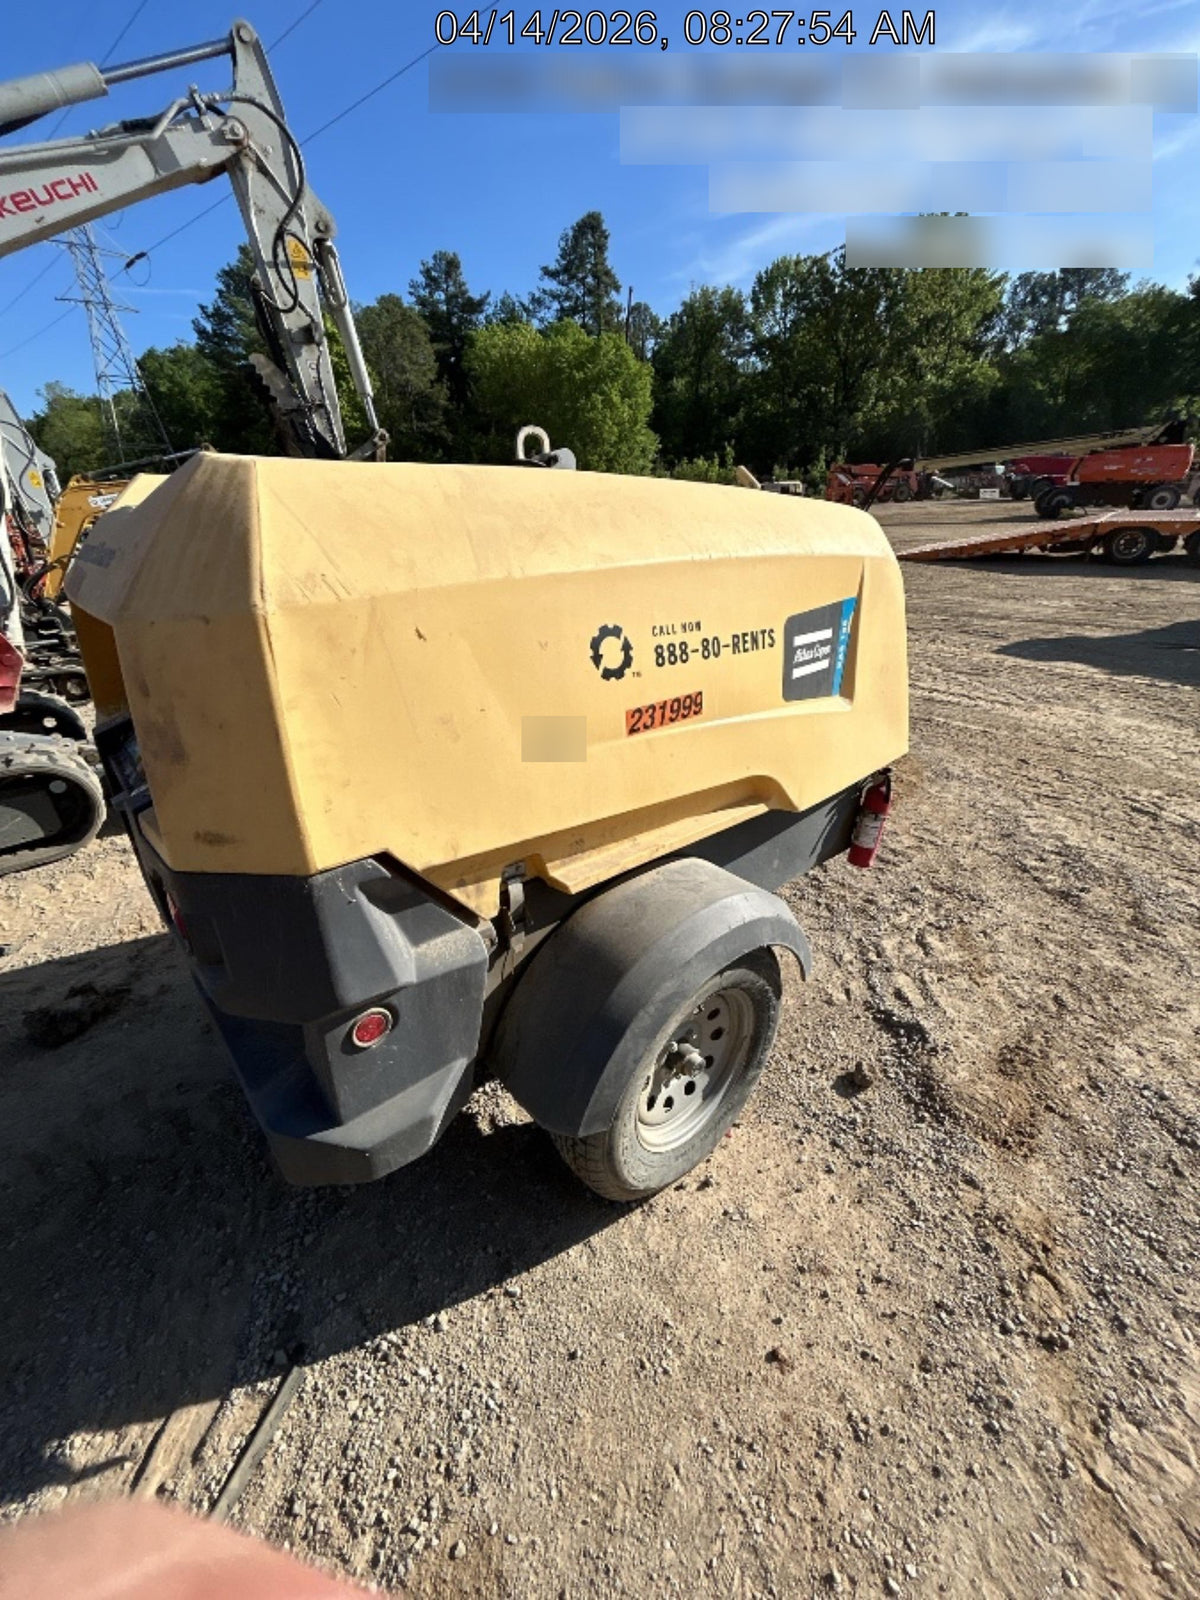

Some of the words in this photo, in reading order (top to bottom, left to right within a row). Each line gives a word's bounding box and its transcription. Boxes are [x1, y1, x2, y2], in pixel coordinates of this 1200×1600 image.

[652, 625, 677, 637] CALL
[681, 620, 702, 633] NOW
[654, 628, 776, 667] 888-80-RENTS
[628, 691, 703, 735] 231999
